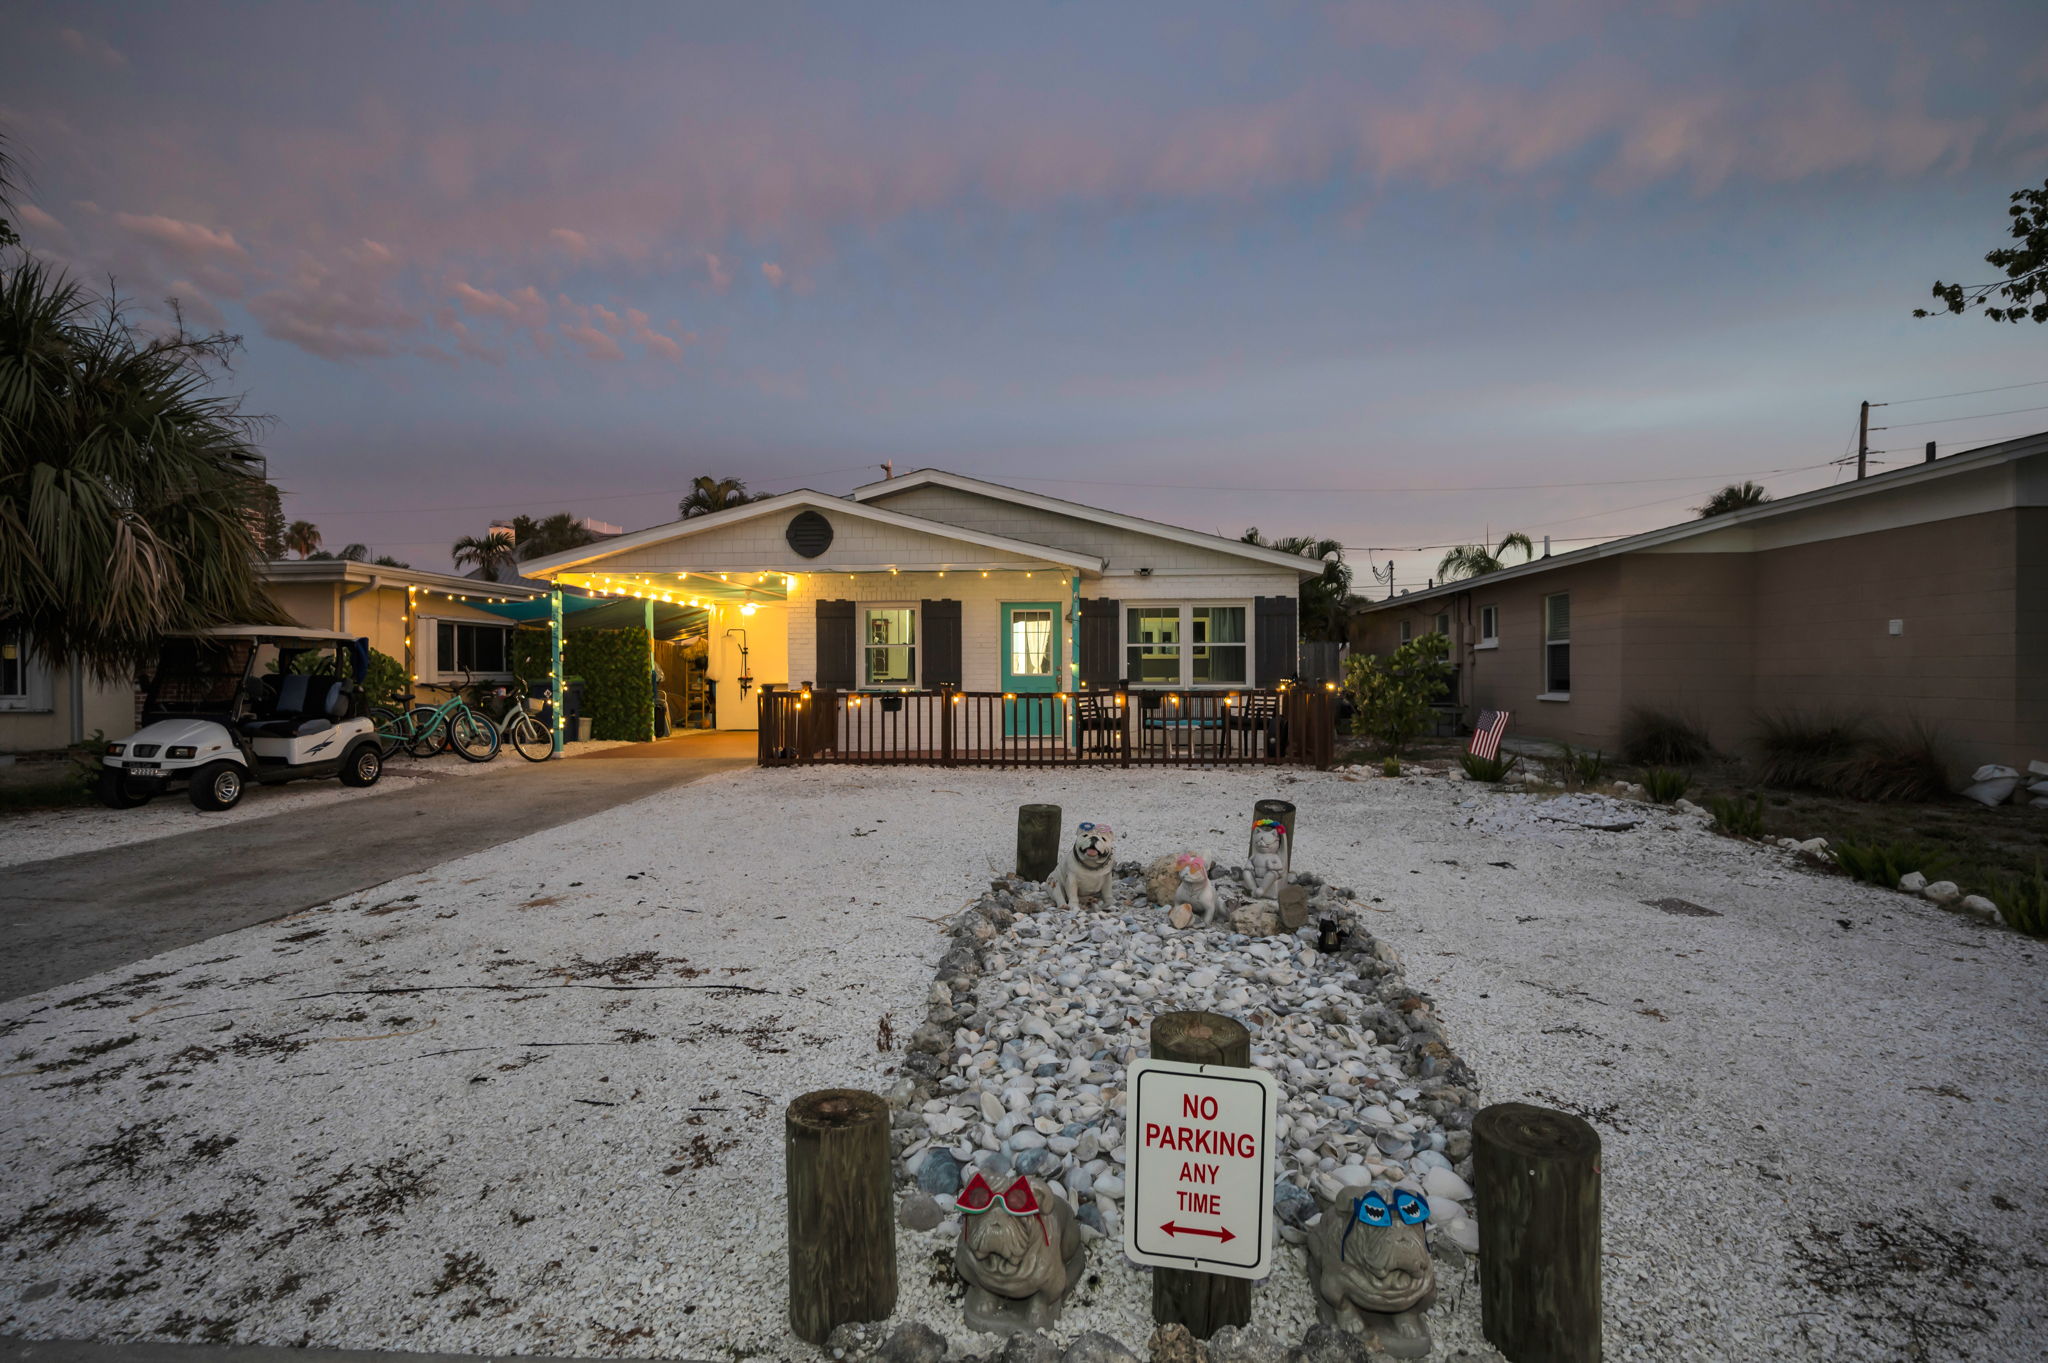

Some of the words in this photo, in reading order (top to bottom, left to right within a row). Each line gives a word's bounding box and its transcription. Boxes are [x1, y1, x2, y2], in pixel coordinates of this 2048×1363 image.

[1183, 1094, 1218, 1120] NO
[1145, 1123, 1254, 1158] PARKING
[1179, 1162, 1219, 1184] ANY
[1176, 1191, 1220, 1214] TIME
